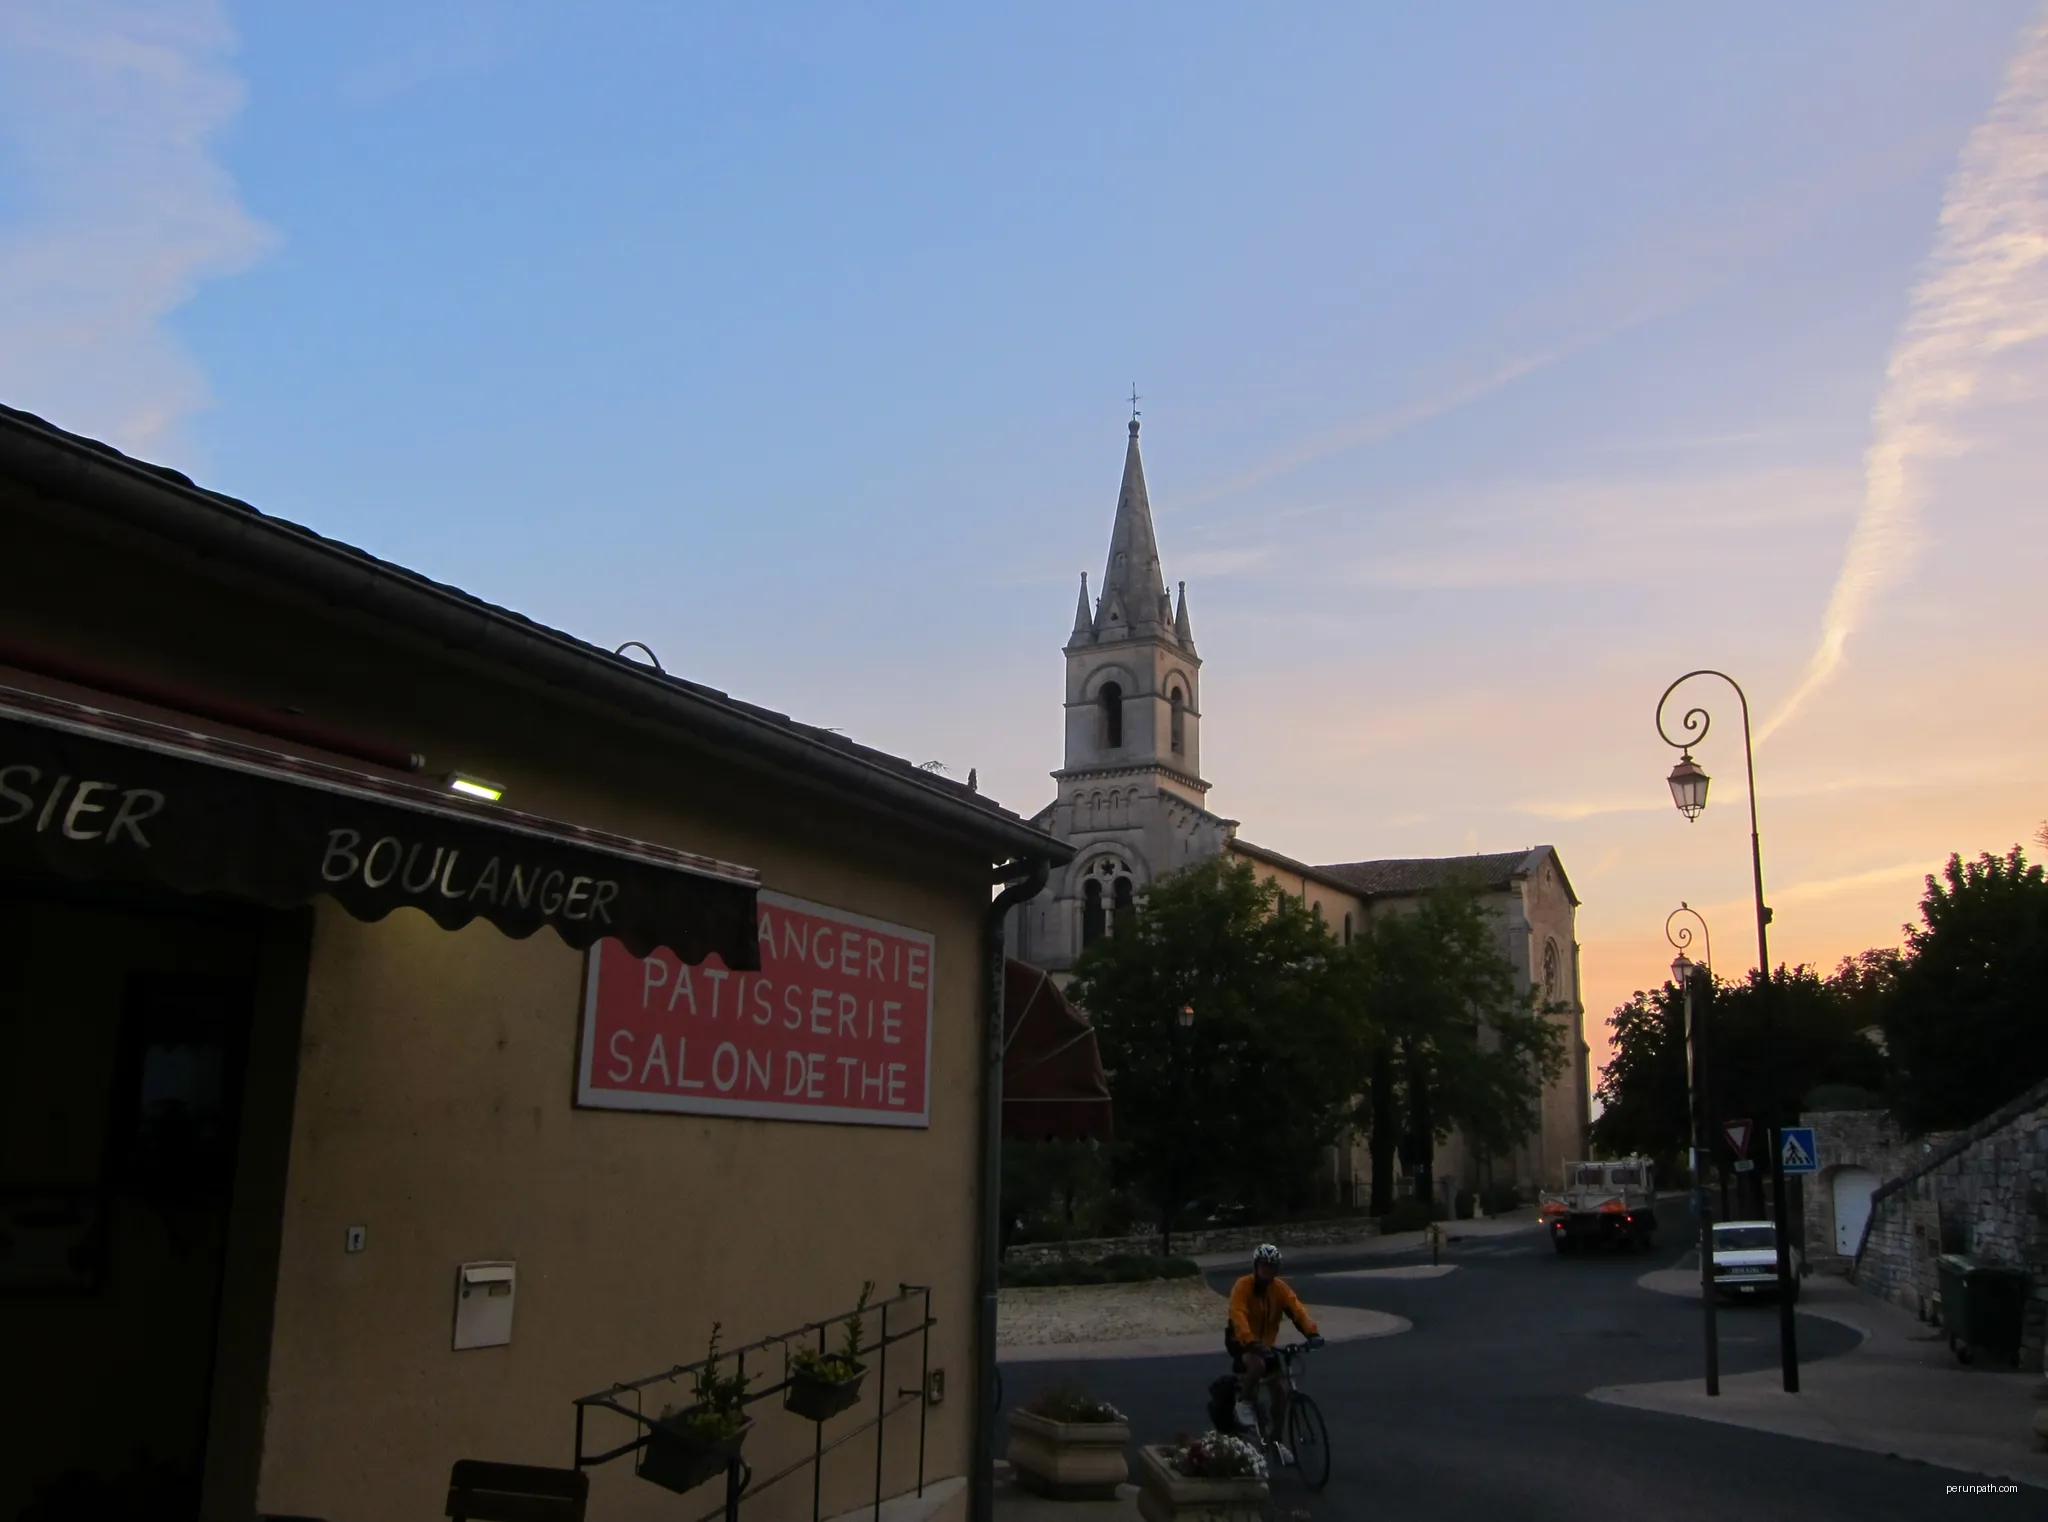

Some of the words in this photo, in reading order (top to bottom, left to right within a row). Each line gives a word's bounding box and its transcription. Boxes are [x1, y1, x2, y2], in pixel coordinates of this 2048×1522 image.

[0, 764, 166, 849] SIER
[321, 828, 619, 924] BOULANGER
[757, 911, 926, 990] ANGERIE
[642, 957, 902, 1044] PATISSERIE
[607, 1029, 771, 1092] SALON
[783, 1050, 827, 1099] DE
[836, 1056, 907, 1106] THE
